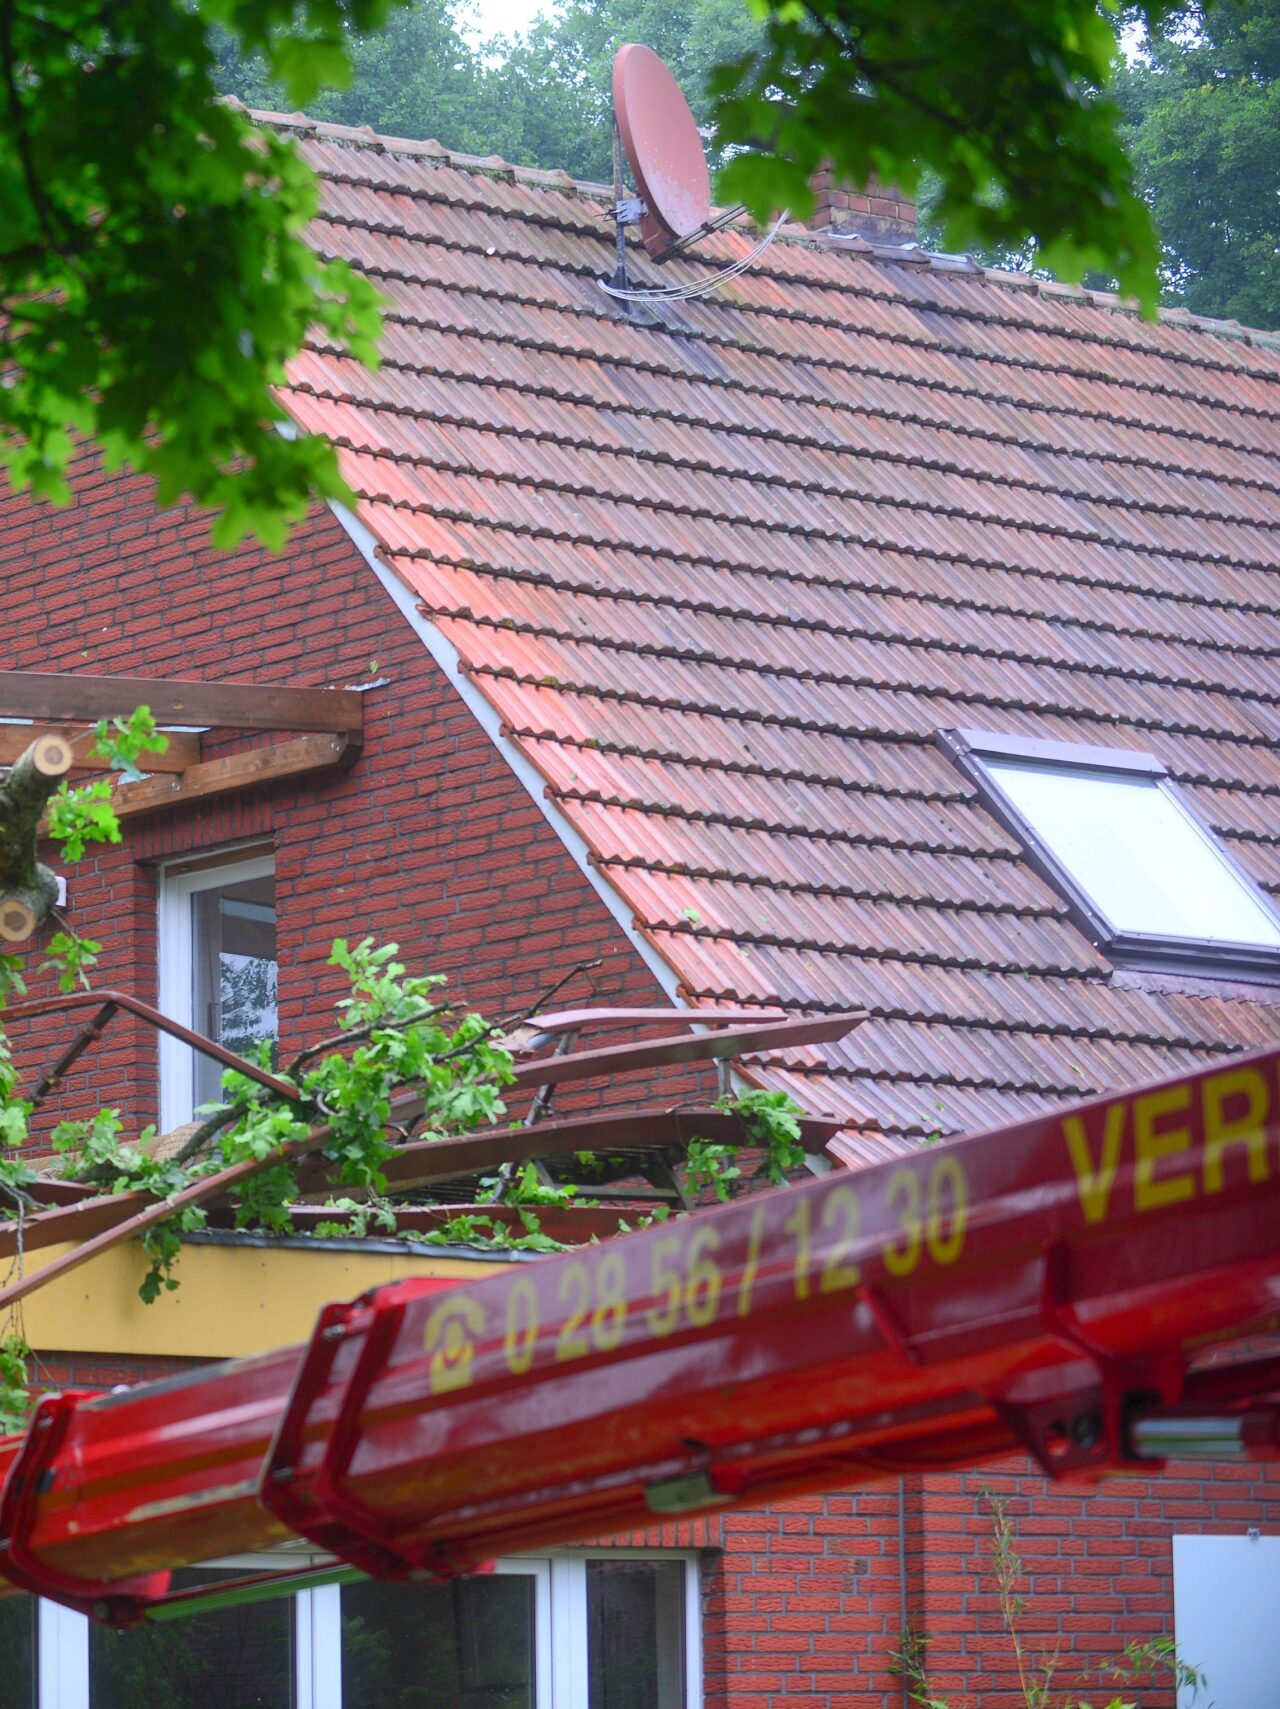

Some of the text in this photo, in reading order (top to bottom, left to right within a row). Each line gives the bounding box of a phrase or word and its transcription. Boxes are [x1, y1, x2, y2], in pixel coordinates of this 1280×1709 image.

[1061, 1060, 1280, 1224] VER
[504, 1156, 967, 1375] 0 28 56 / 12 30
